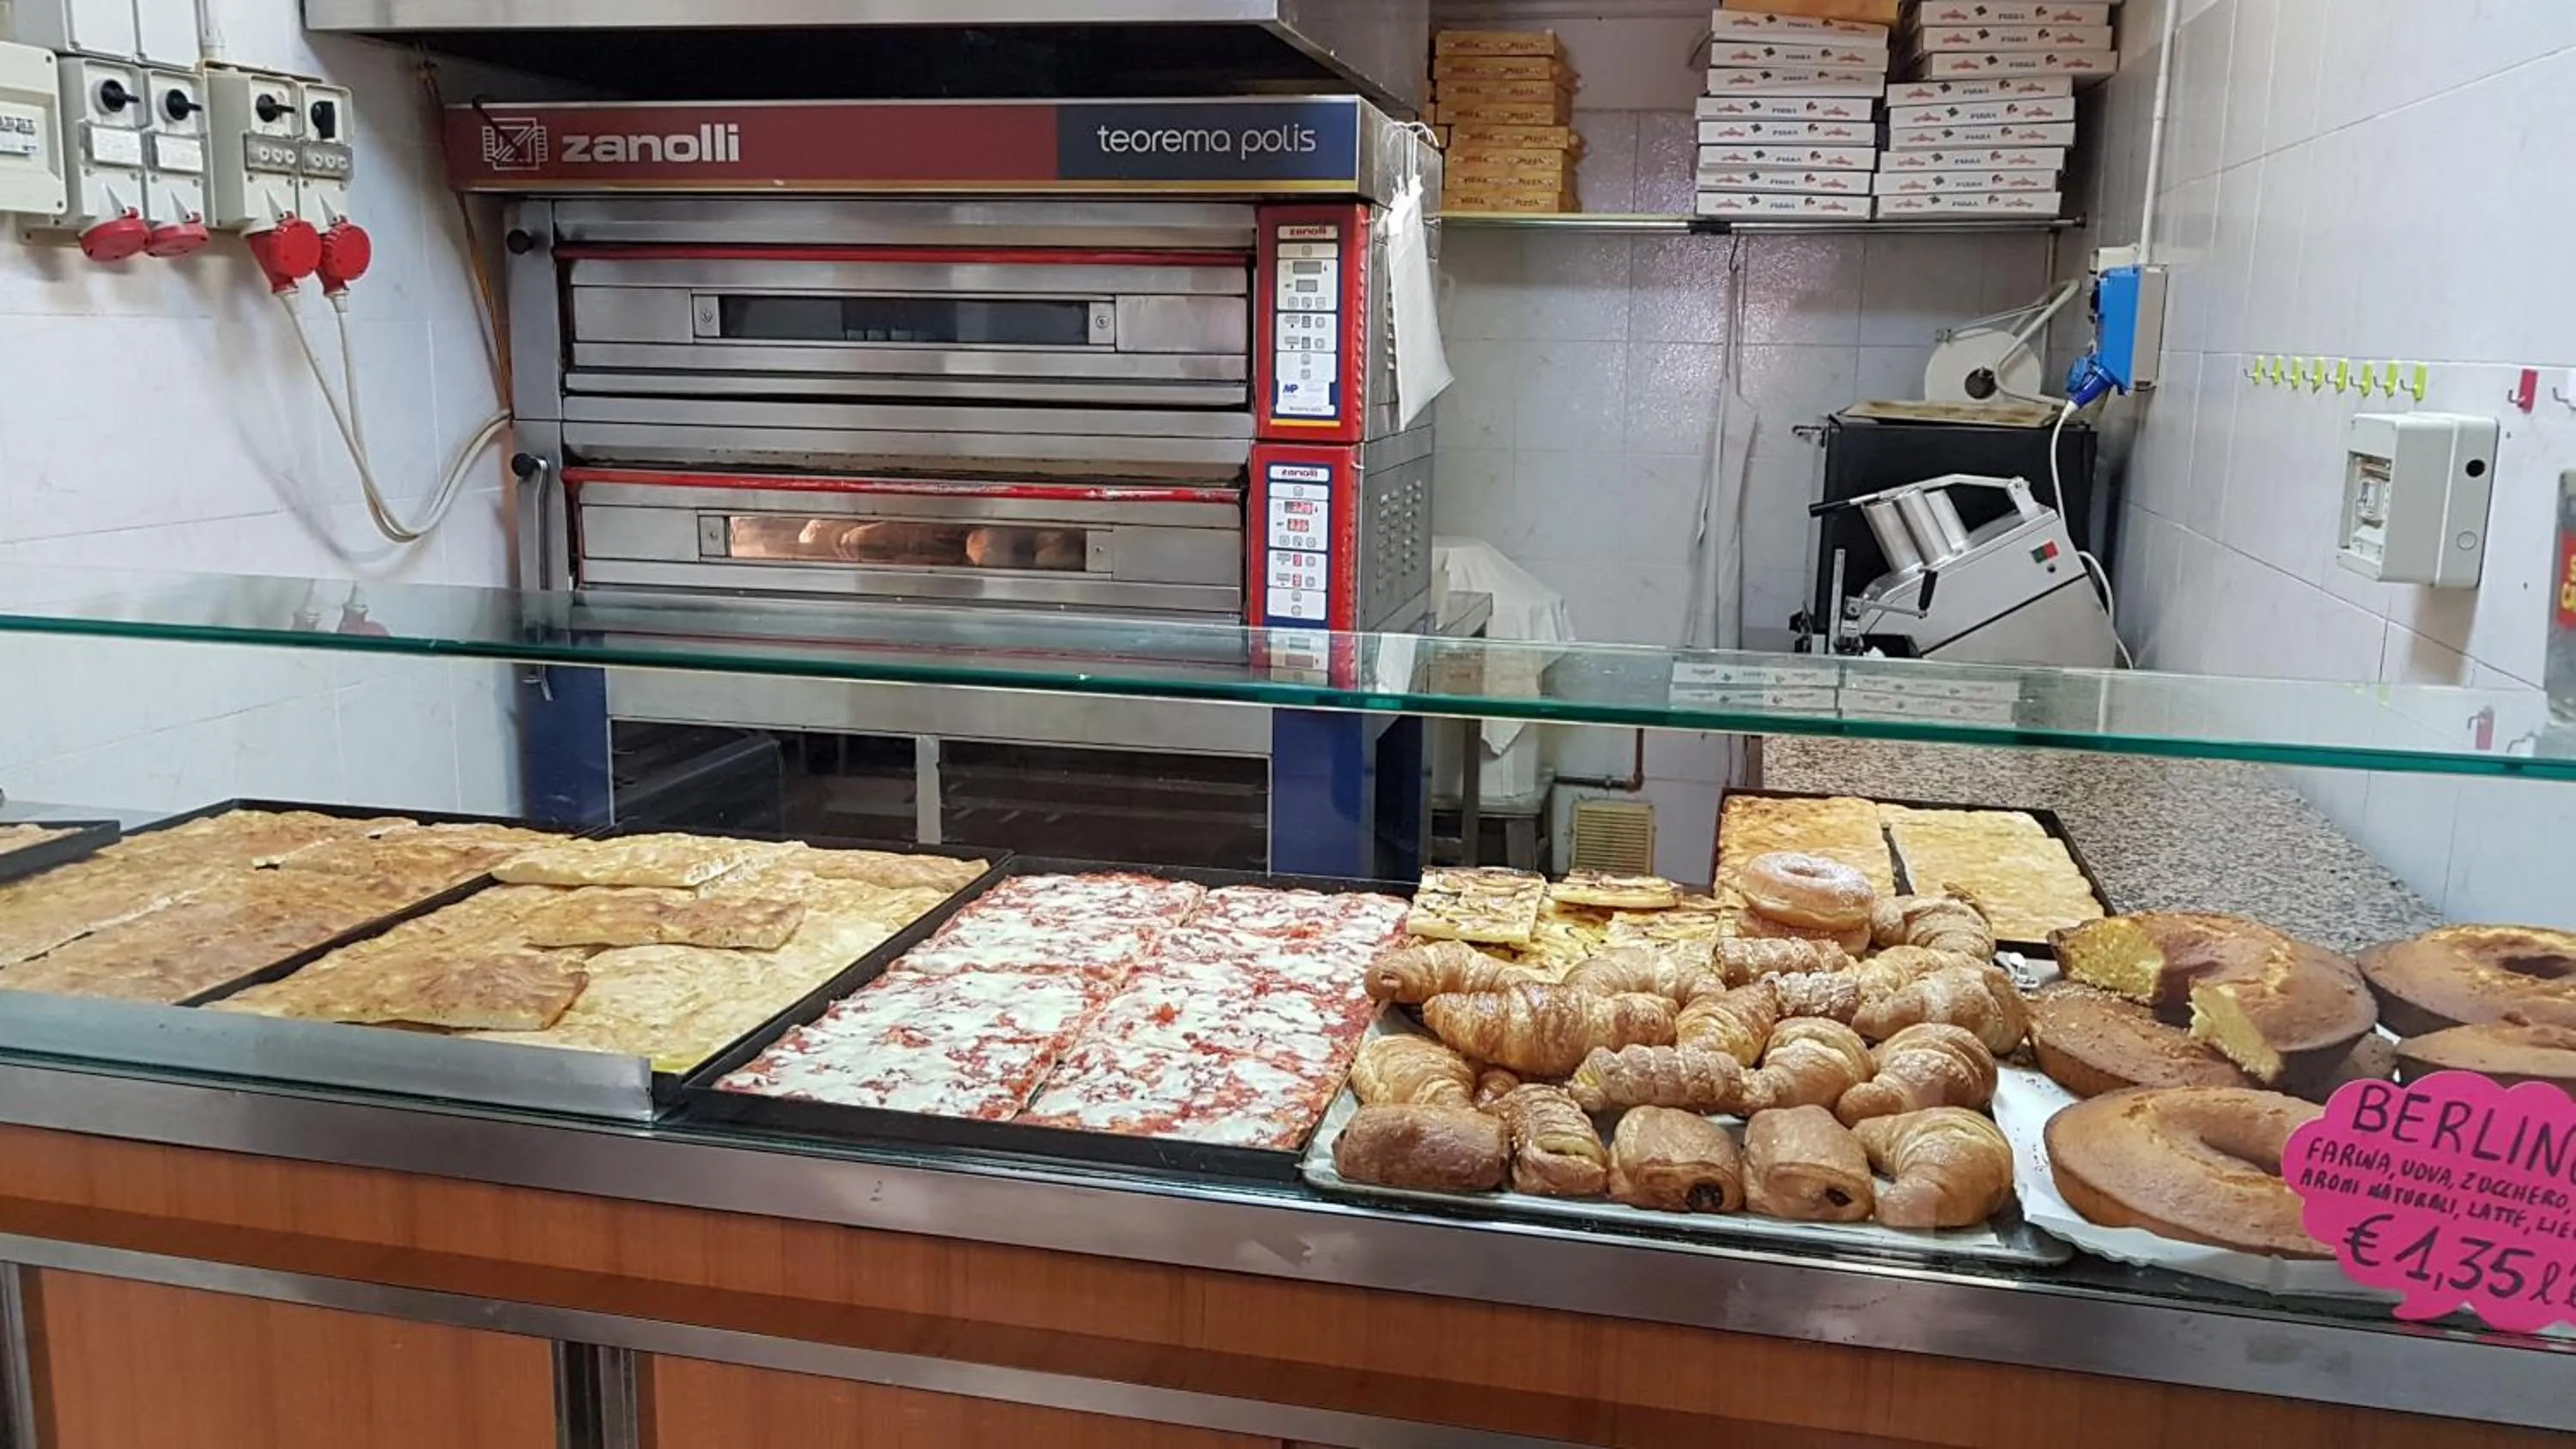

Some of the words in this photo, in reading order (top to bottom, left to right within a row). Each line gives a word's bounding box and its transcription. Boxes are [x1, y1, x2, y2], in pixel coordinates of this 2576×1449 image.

[562, 124, 740, 163] zanolli
[1097, 125, 1231, 154] teorema
[1241, 124, 1316, 161] polis
[2352, 1084, 2576, 1185] BERLIN
[2401, 1159, 2455, 1190] UOVA,
[2467, 1201, 2530, 1235] LATTE,
[2536, 1216, 2576, 1240] LIE
